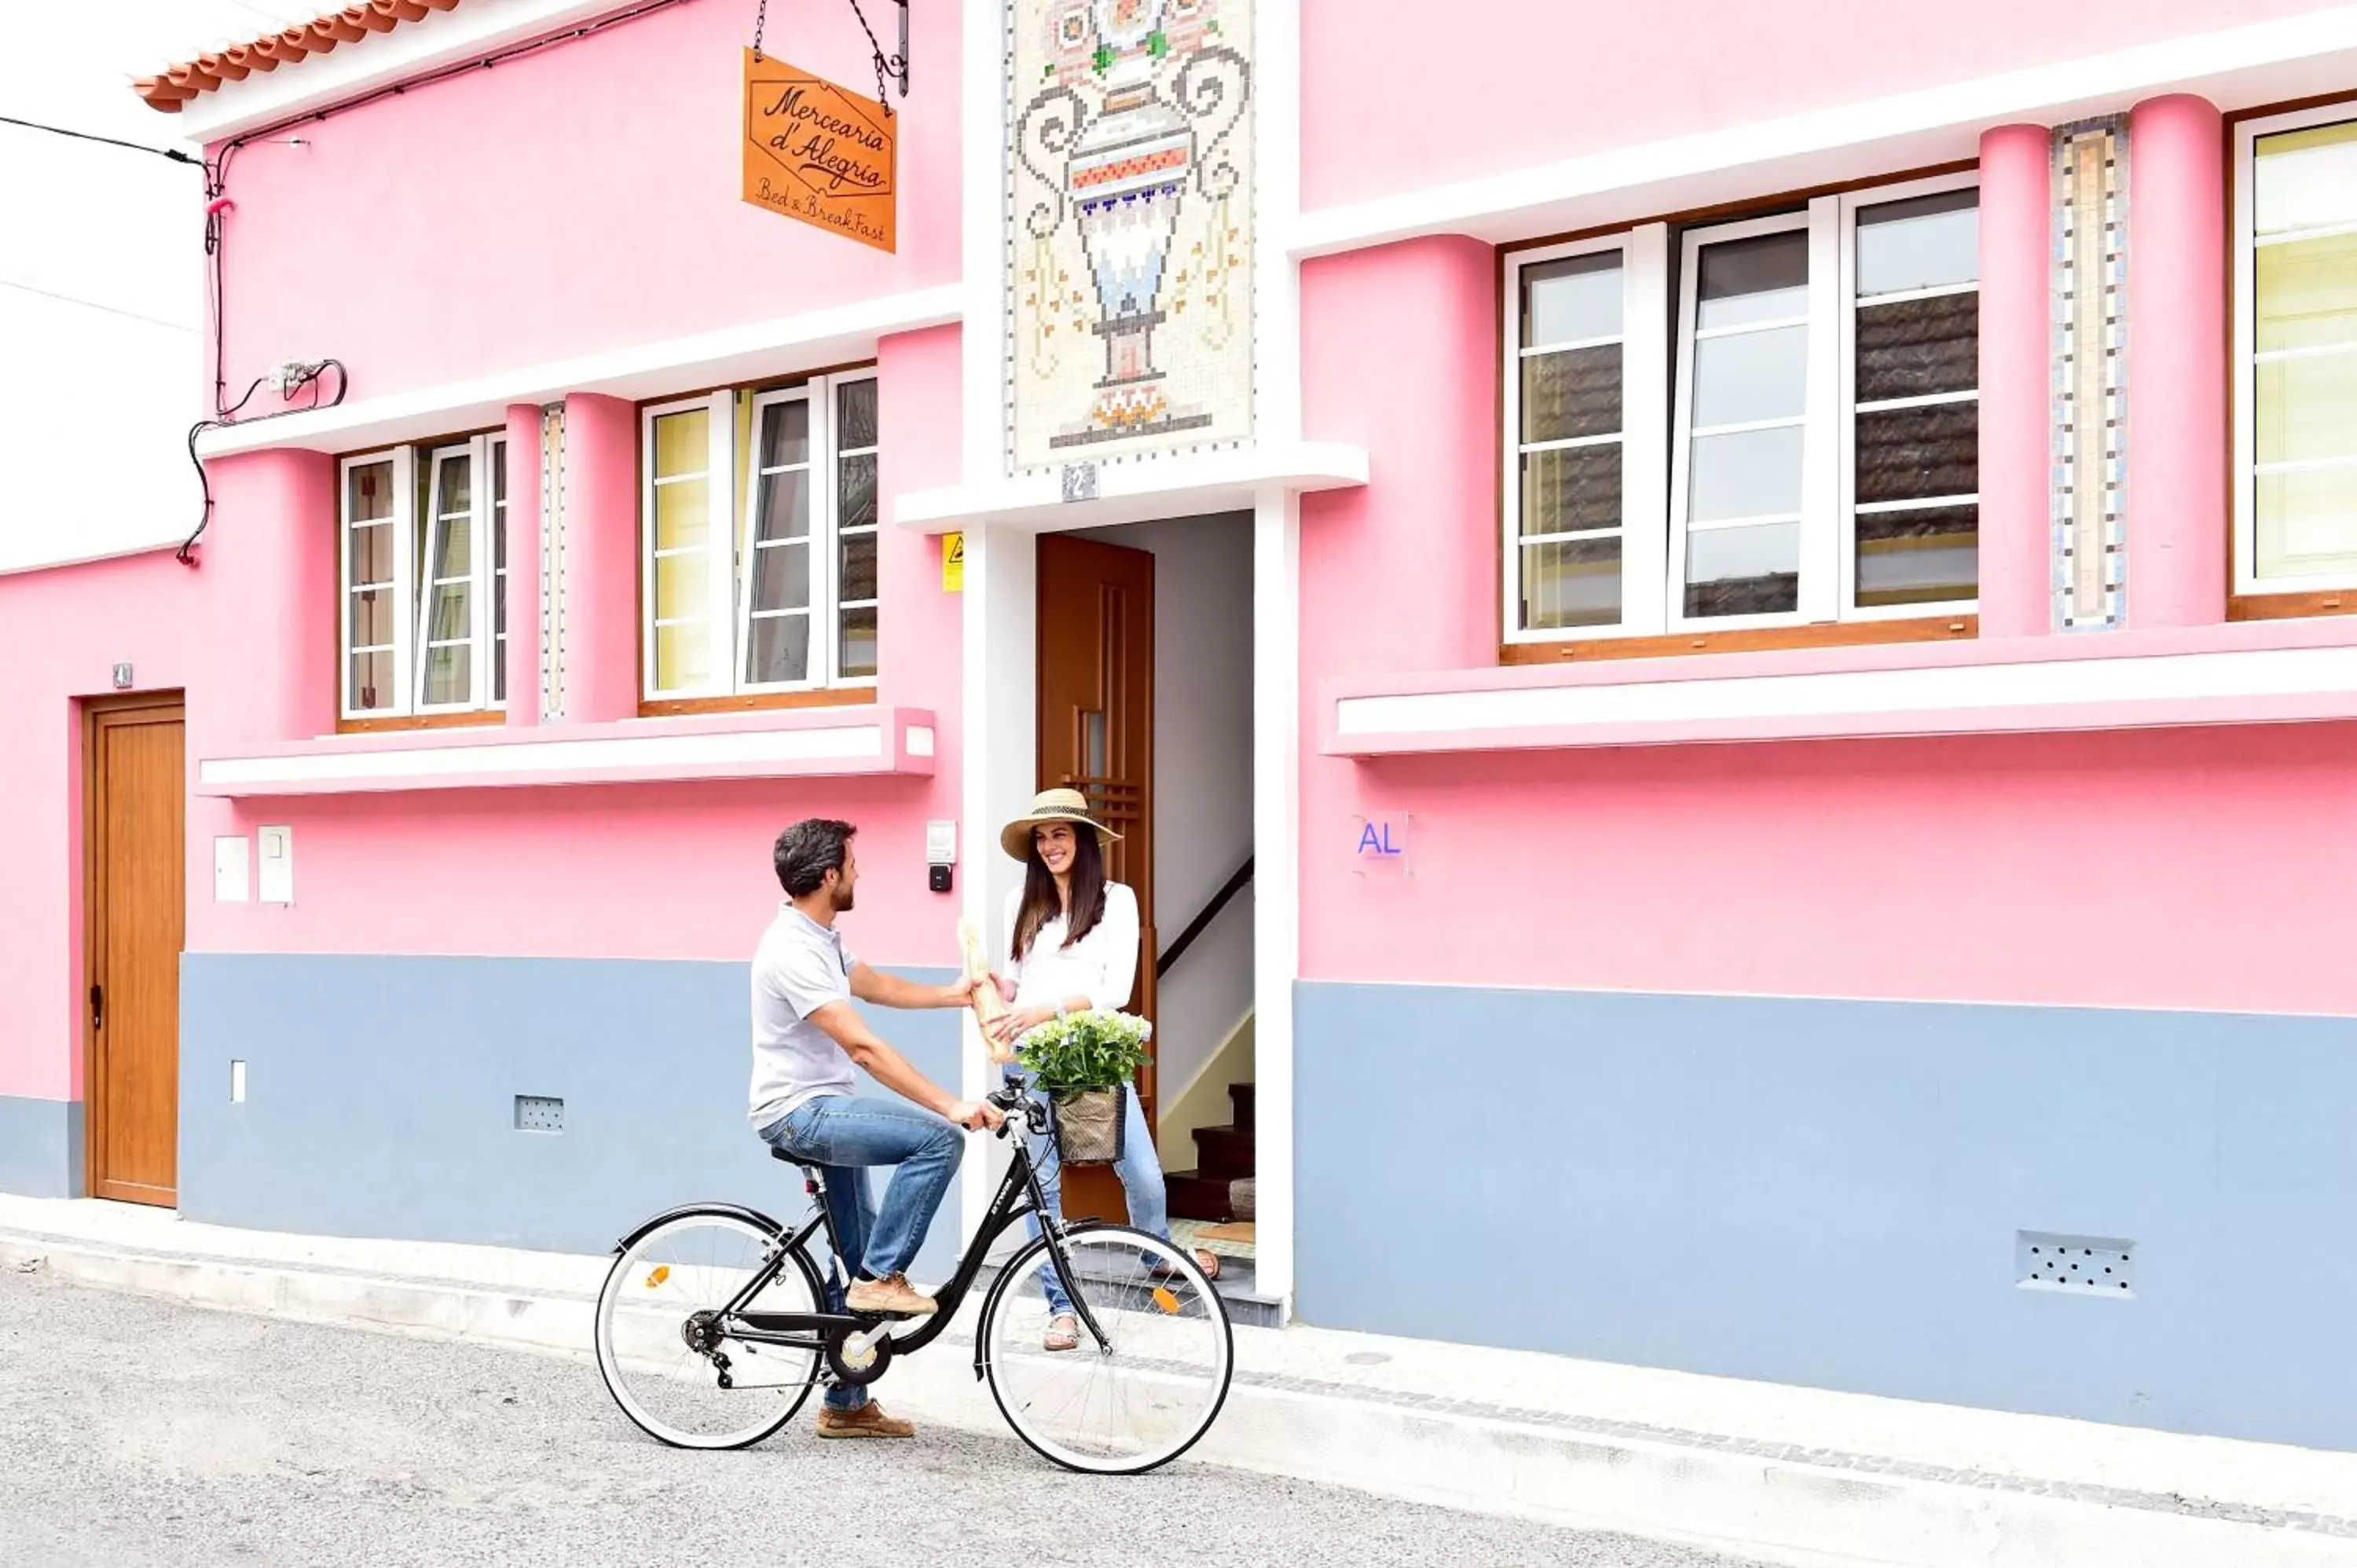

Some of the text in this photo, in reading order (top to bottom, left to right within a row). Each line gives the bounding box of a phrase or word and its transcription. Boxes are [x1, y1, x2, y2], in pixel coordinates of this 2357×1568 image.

[764, 86, 884, 152] Mercearia
[769, 122, 886, 190] d'Alegria
[756, 177, 790, 207] Bed
[791, 197, 801, 211] &
[1357, 822, 1402, 854] AL
